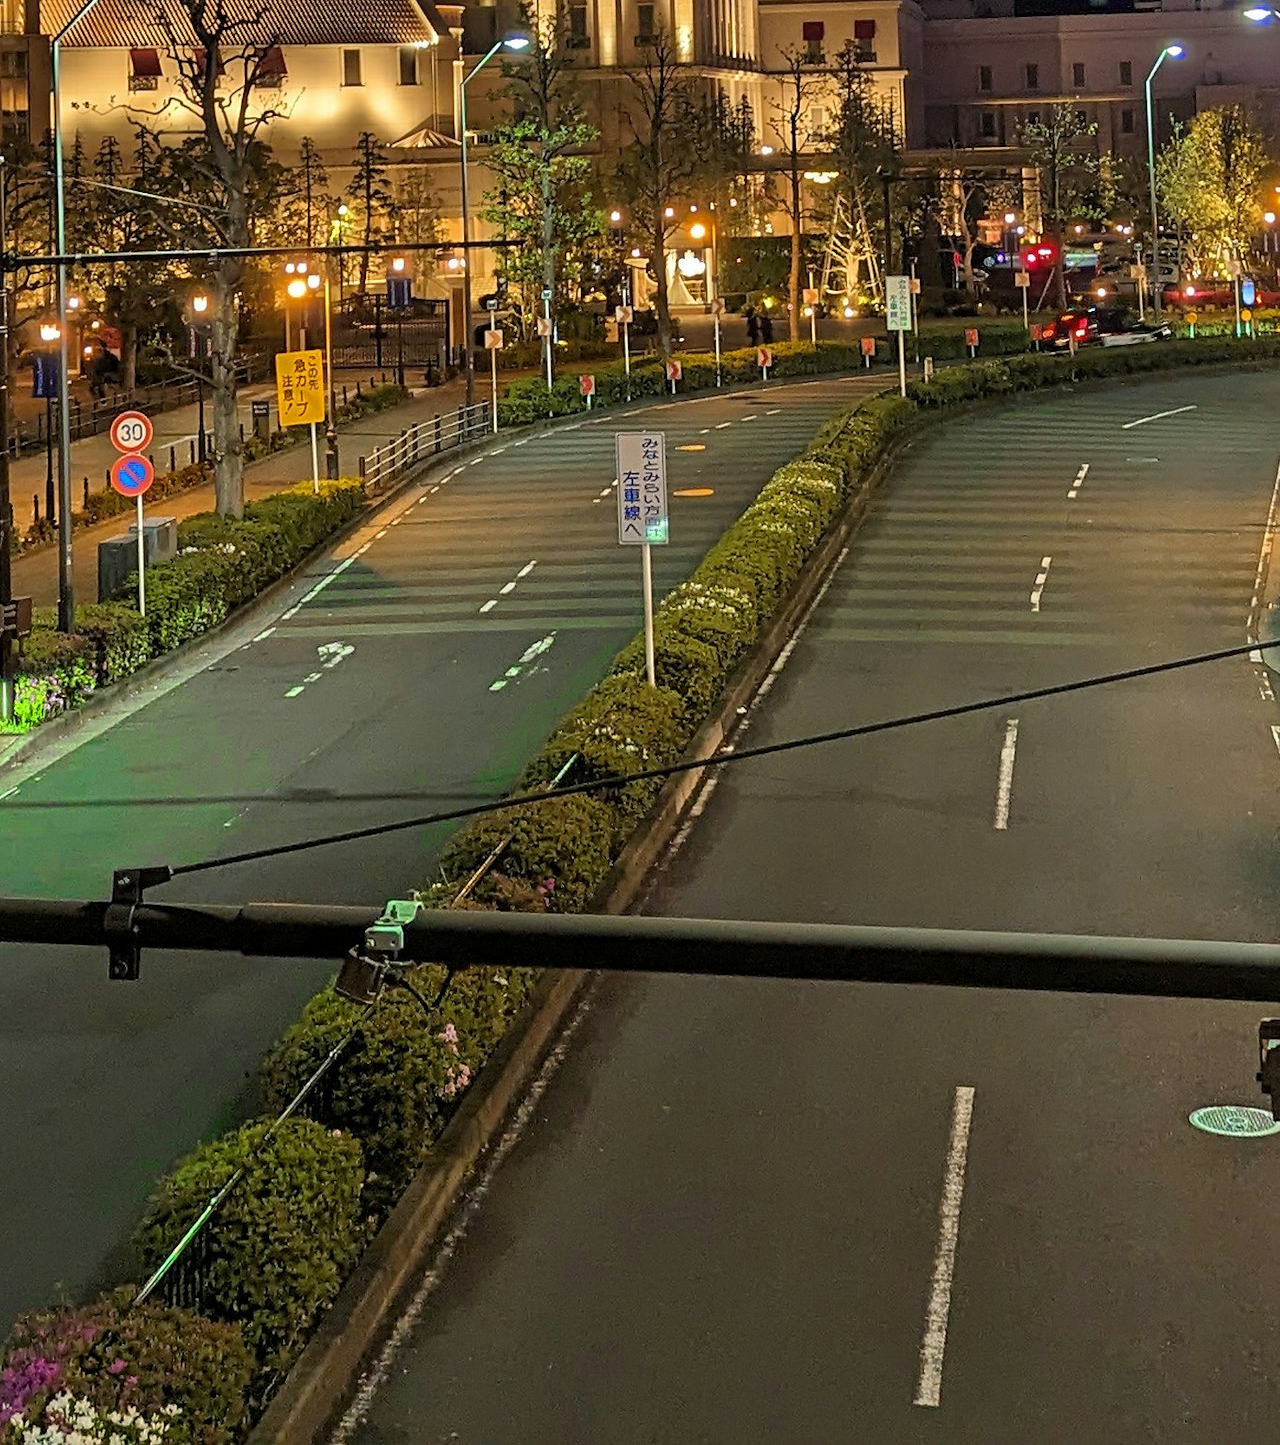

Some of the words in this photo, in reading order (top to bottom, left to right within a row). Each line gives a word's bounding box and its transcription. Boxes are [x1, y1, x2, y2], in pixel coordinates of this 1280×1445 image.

[121, 423, 143, 442] 30
[622, 470, 642, 537] 左車線へ
[642, 437, 662, 538] みなとみらい方面は
